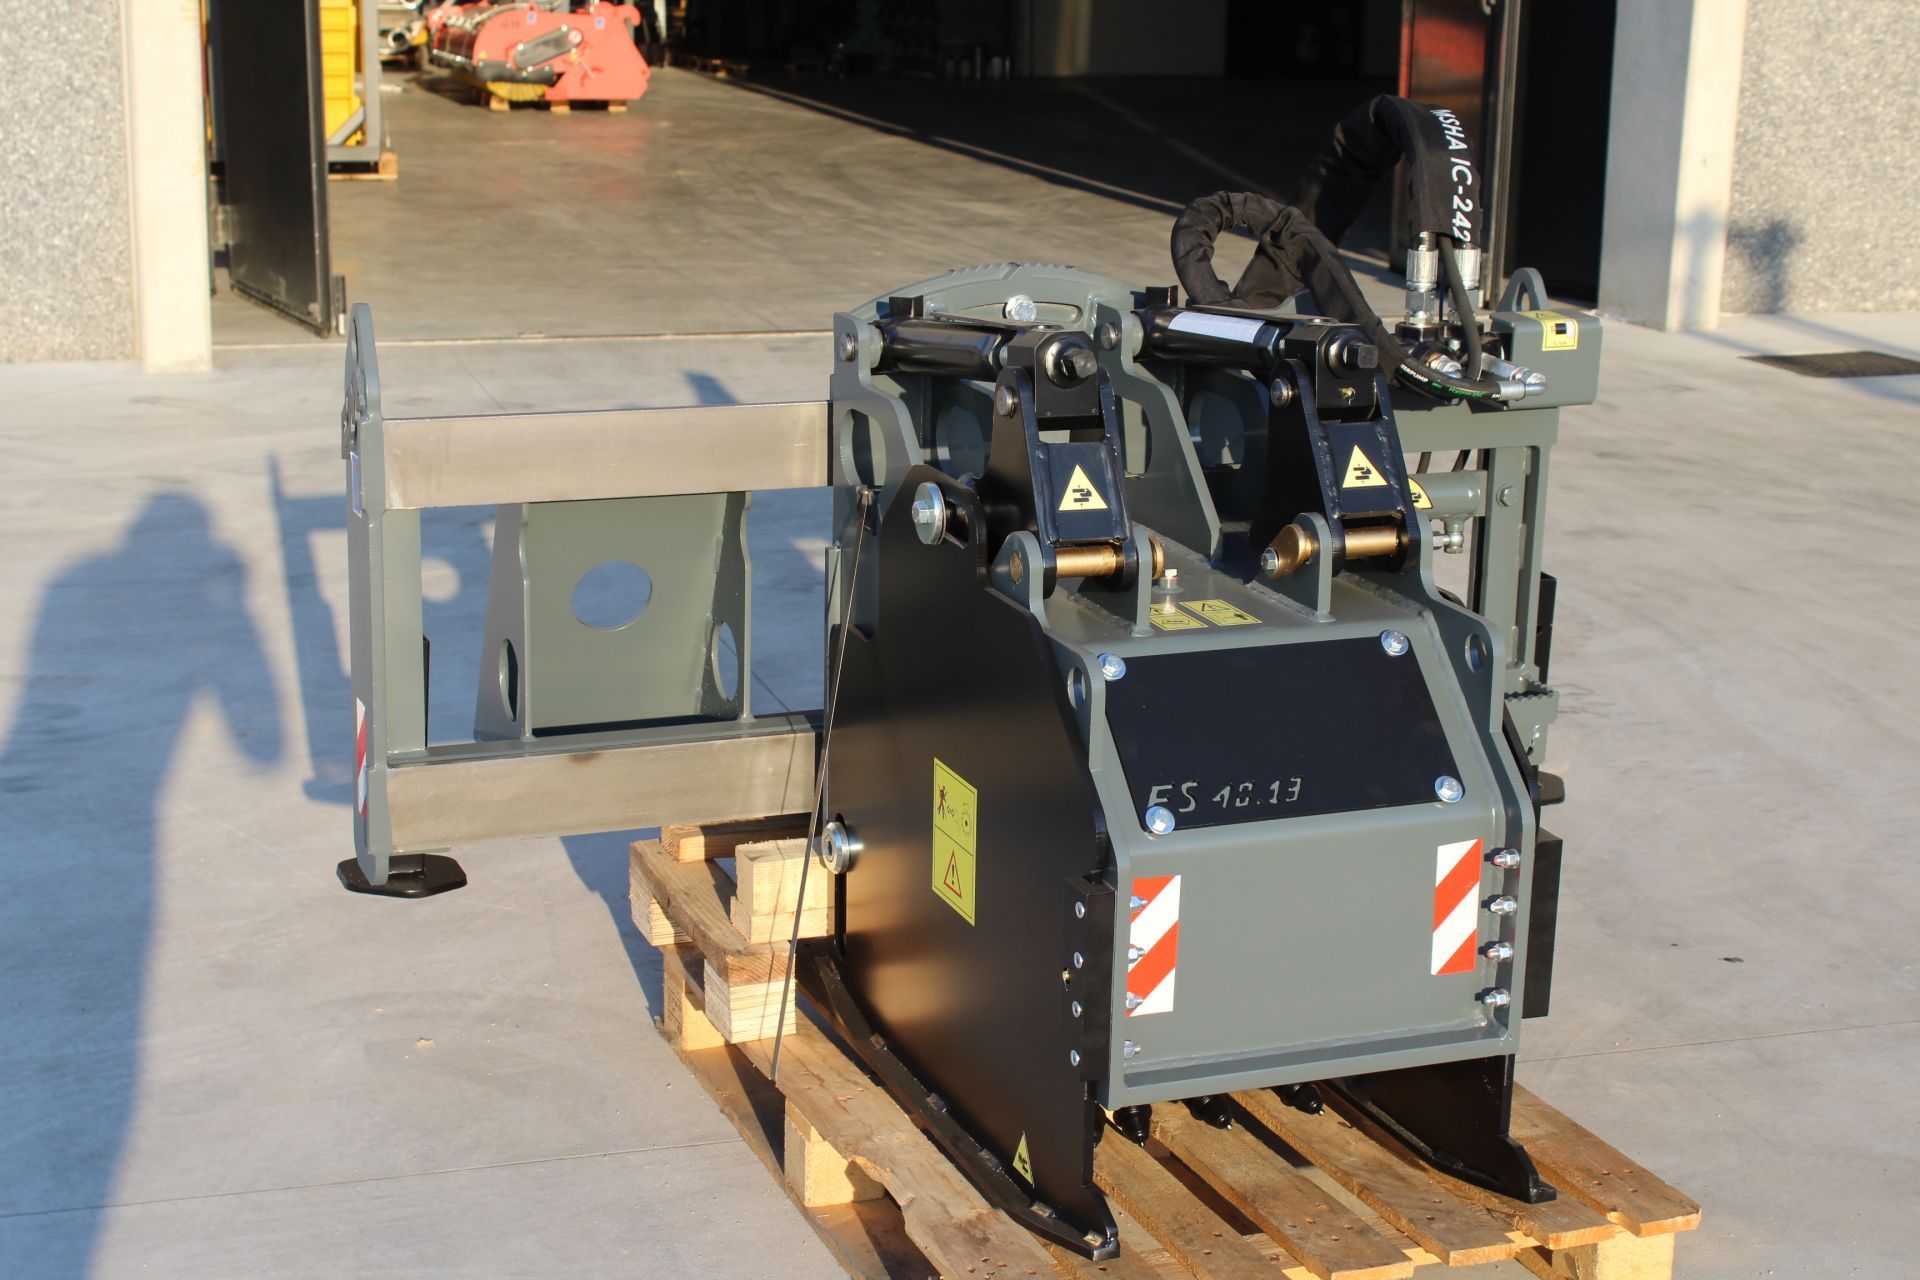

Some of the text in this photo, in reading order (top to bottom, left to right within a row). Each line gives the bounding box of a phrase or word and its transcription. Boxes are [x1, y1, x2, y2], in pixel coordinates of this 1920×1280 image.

[1430, 109, 1473, 242] MSHA IC-242
[1400, 363, 1429, 382] TERPUMP
